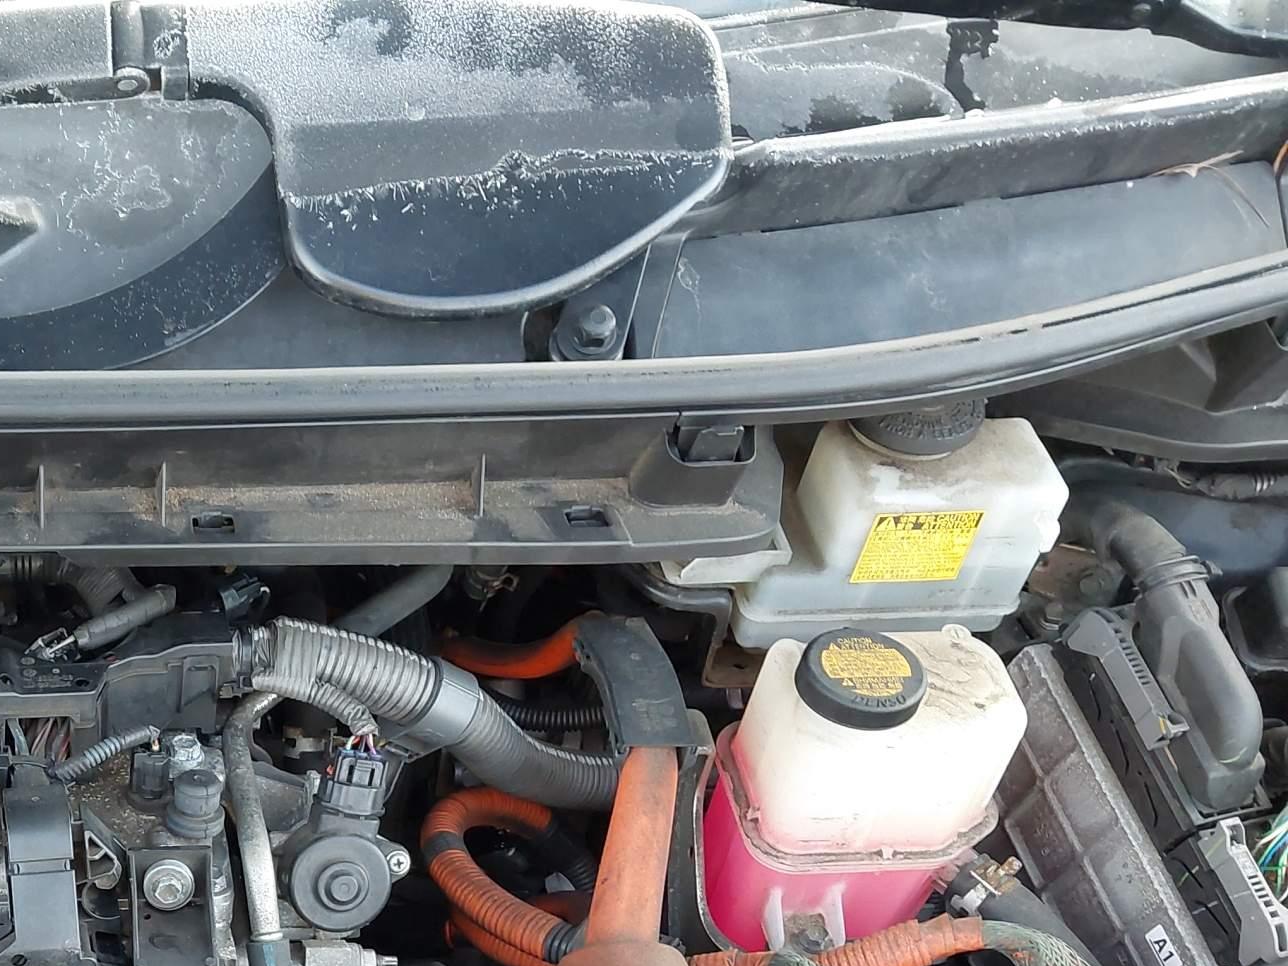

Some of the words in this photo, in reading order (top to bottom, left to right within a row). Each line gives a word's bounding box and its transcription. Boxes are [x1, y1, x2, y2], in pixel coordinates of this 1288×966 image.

[936, 512, 980, 523] CAUTION
[921, 520, 978, 530] ATTENTION
[1153, 939, 1174, 962] A1
